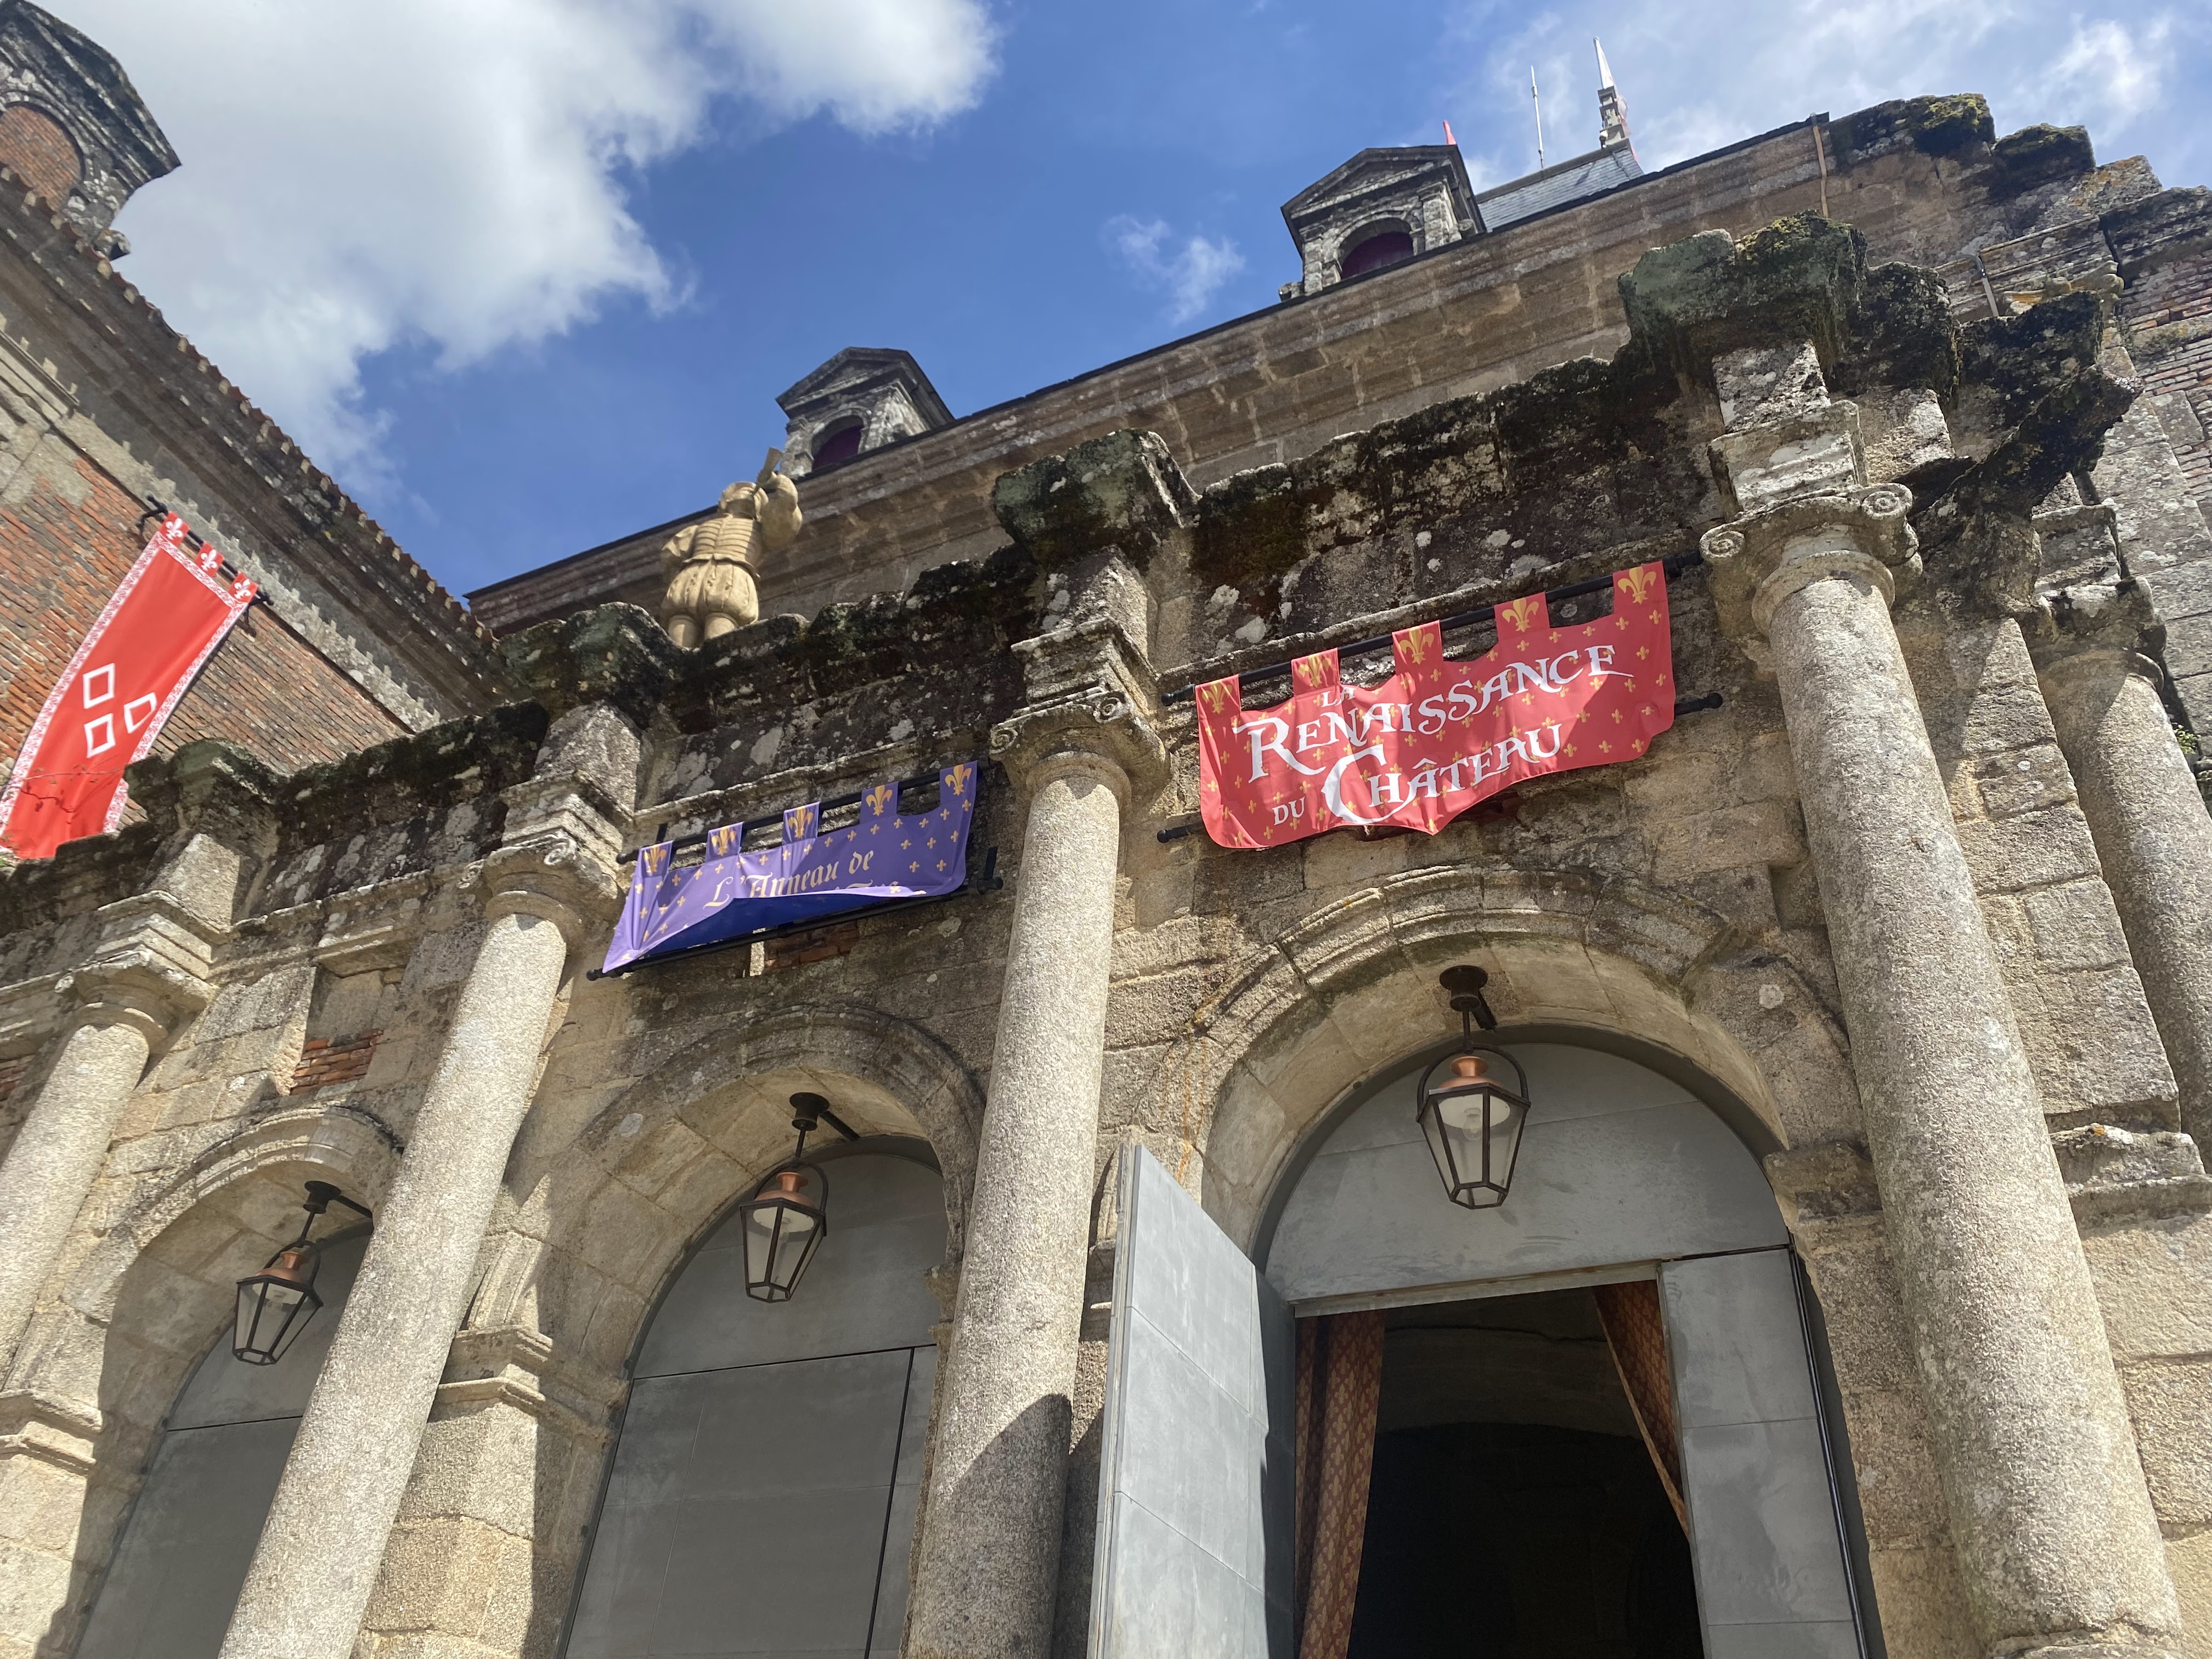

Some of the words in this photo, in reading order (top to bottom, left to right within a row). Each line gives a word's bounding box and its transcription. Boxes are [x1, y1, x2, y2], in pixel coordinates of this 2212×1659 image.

[1232, 645, 1634, 783] RENAISSANCE
[1321, 686, 1357, 707] LA
[1272, 797, 1305, 826] DU
[1321, 724, 1563, 825] CHÂTEAU
[703, 861, 839, 910] L'Anneau
[848, 849, 874, 874] de
